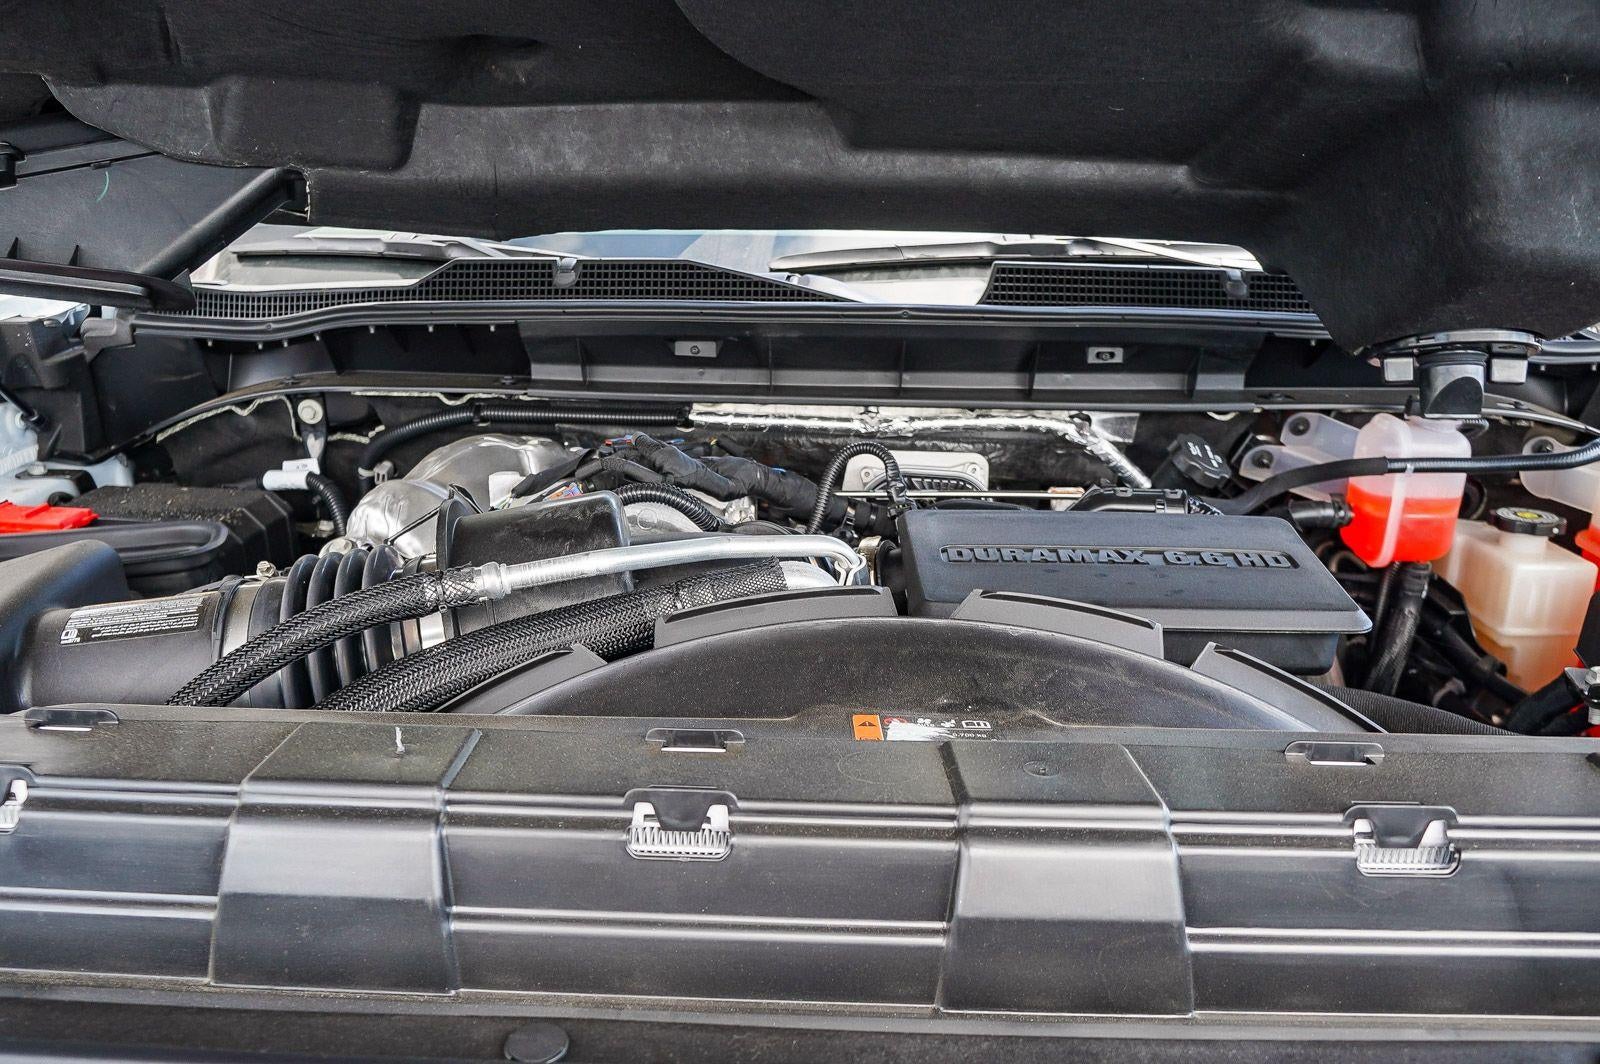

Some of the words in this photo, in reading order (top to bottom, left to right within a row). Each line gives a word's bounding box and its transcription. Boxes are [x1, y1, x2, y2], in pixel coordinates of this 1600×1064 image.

[945, 547, 1149, 565] DURAMAX
[1163, 550, 1225, 567] 6.6
[1233, 551, 1291, 569] HD
